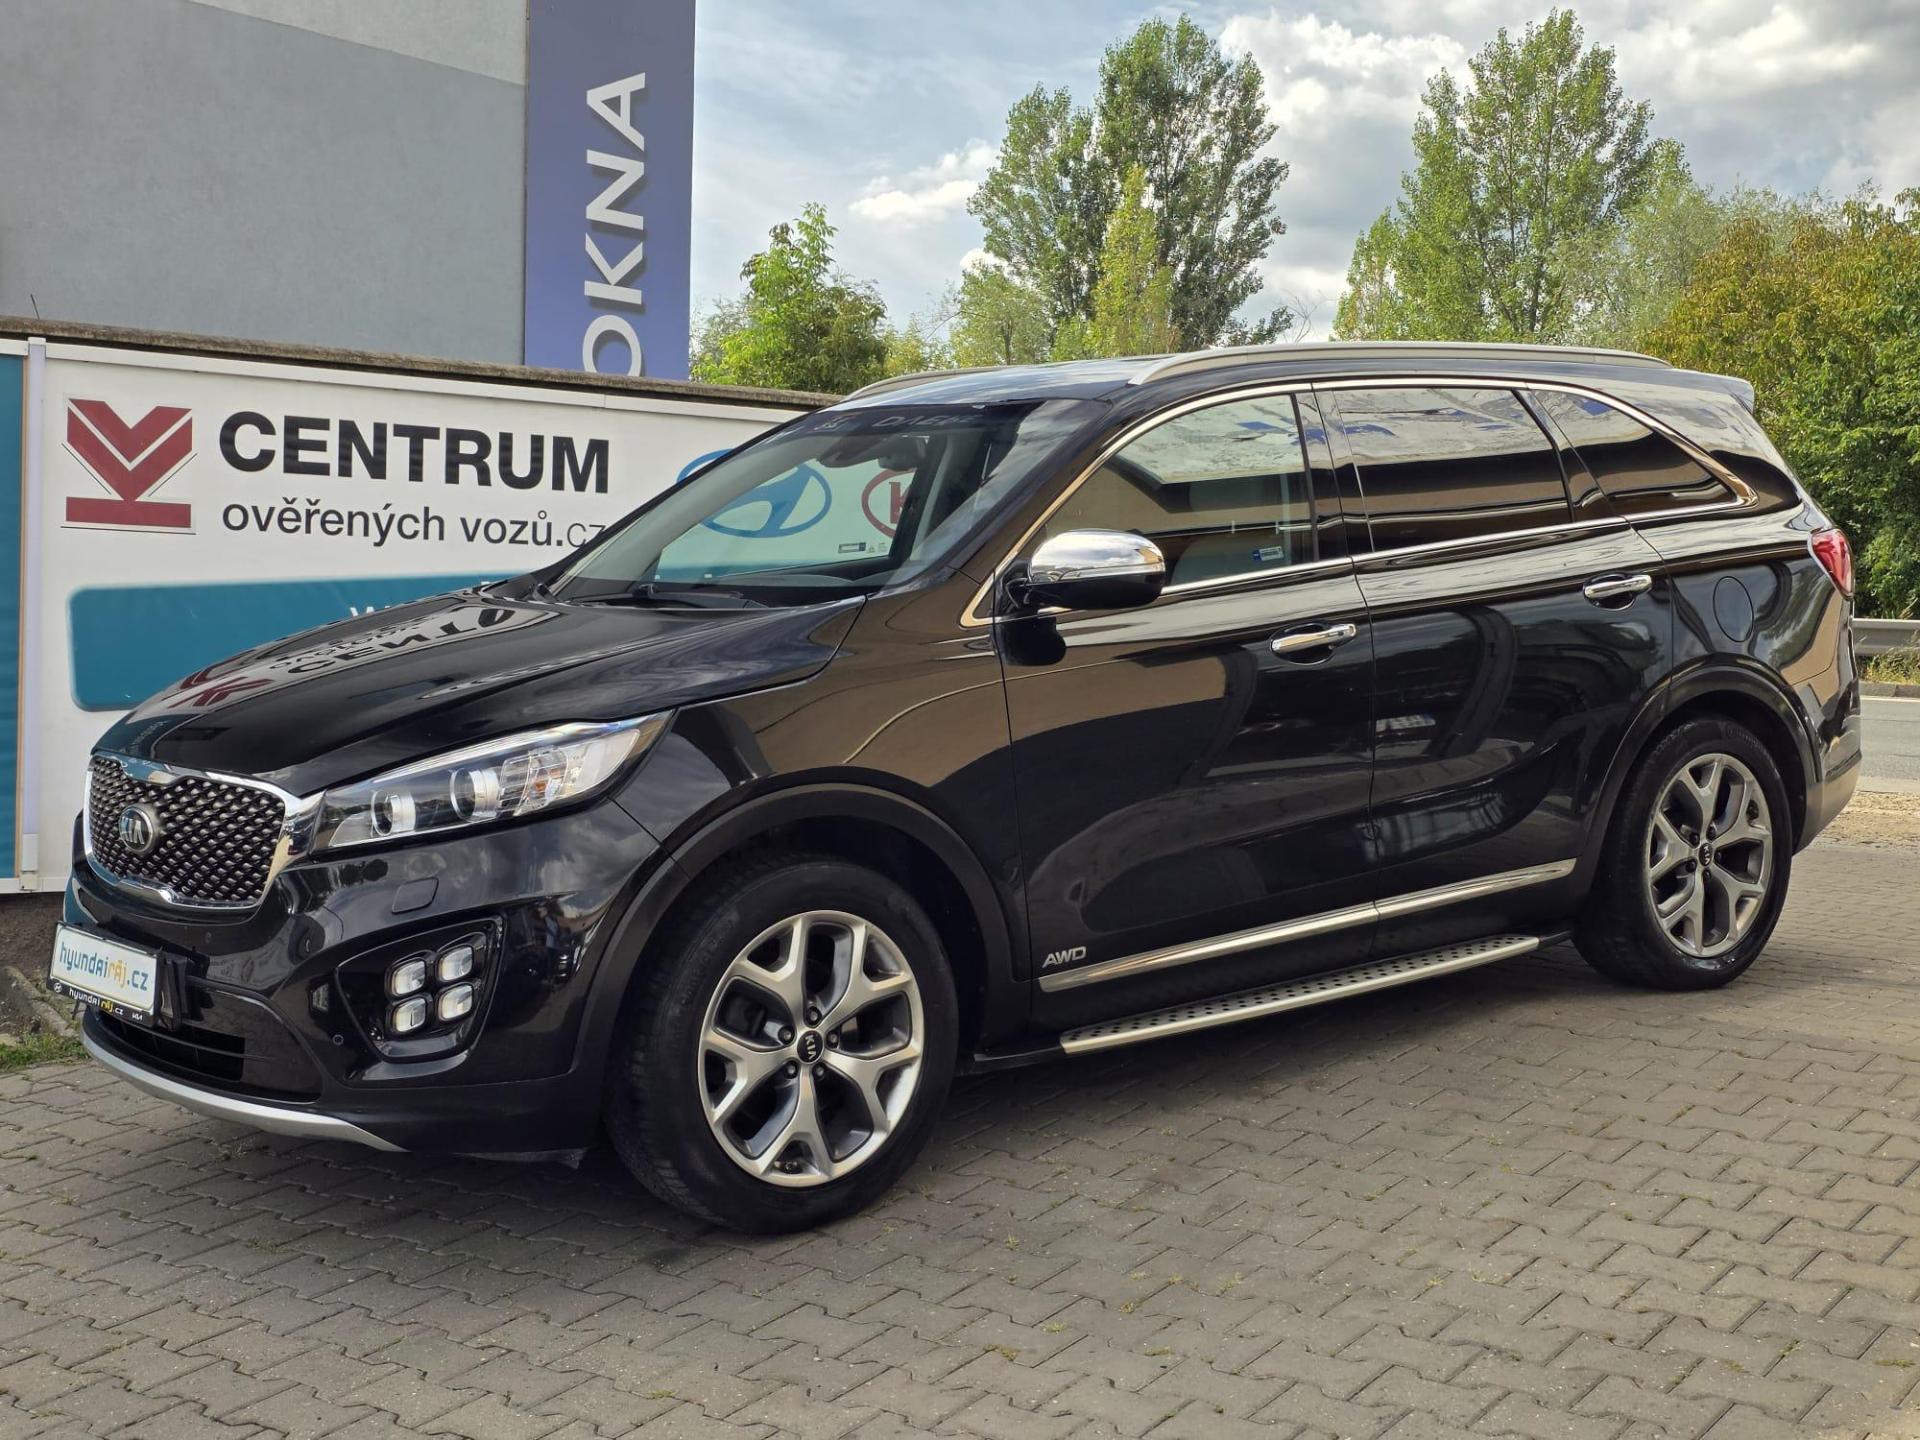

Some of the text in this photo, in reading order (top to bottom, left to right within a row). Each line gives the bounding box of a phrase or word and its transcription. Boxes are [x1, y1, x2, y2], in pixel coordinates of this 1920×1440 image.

[582, 72, 646, 377] OKNA
[219, 411, 609, 494] CENTRUM
[222, 497, 445, 547] ověřených
[1041, 946, 1087, 968] AWD
[805, 1034, 817, 1060] KIA
